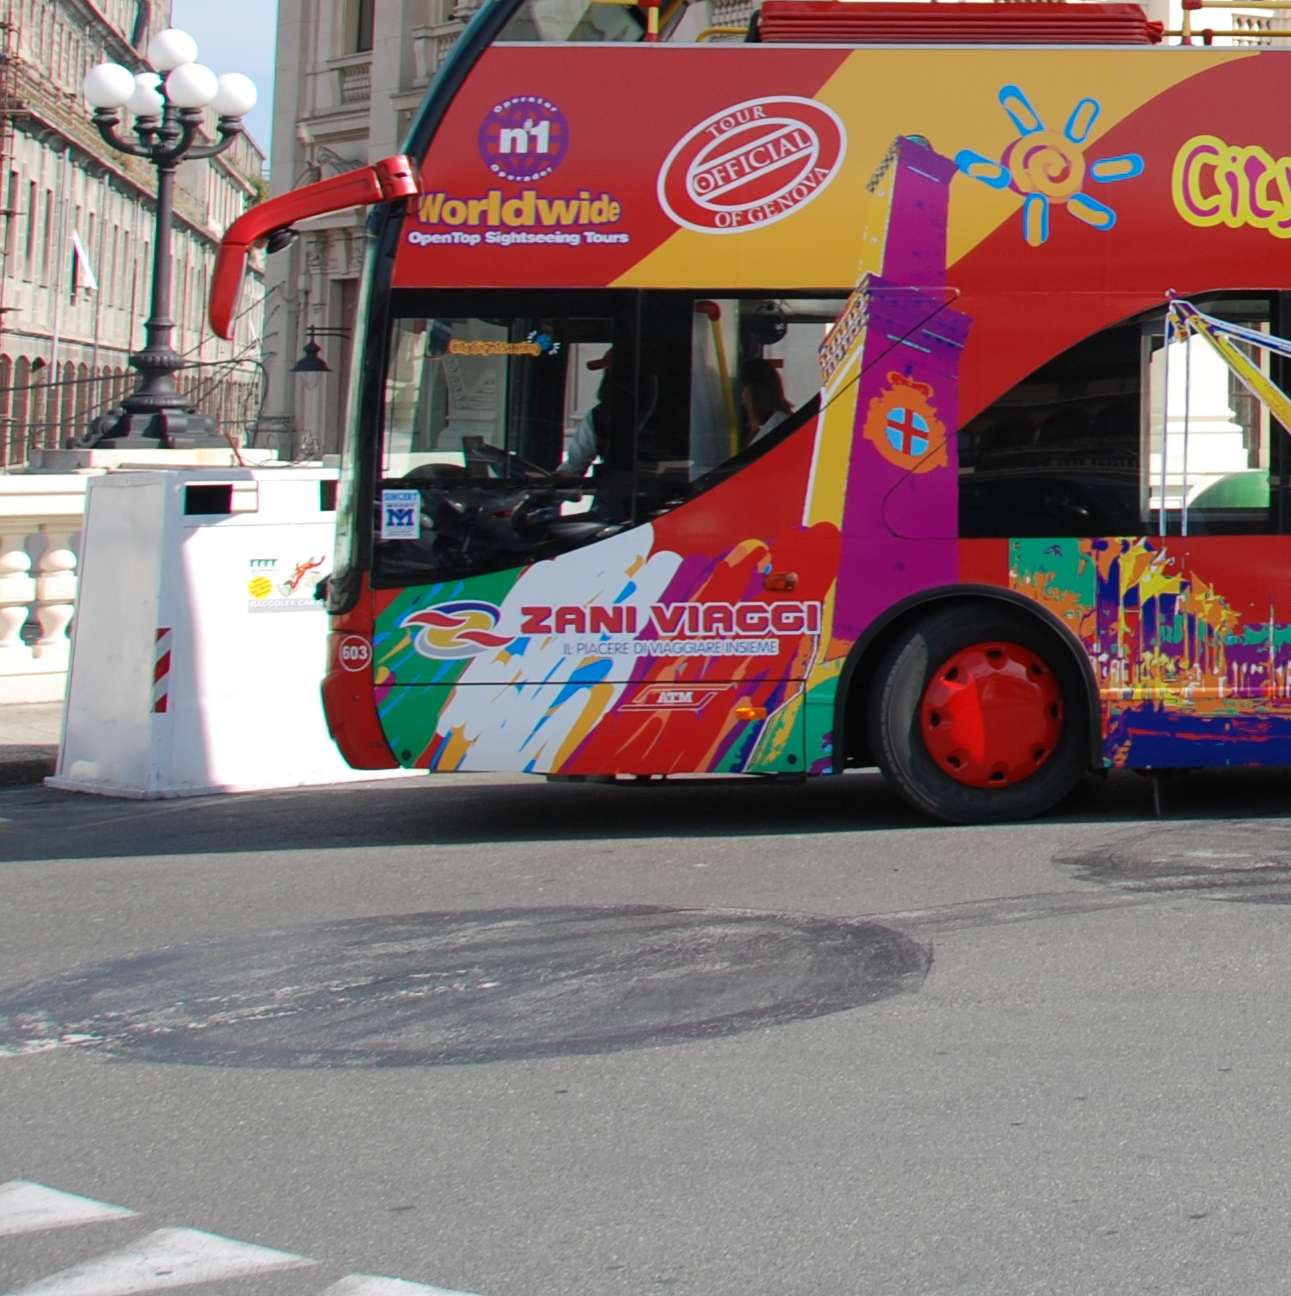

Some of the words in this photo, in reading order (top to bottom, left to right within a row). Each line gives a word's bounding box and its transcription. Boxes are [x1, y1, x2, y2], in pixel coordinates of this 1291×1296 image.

[705, 105, 766, 138] TOUR
[693, 129, 812, 194] OFFICIAL
[418, 190, 621, 227] Worldwide
[714, 211, 742, 228] OF
[747, 165, 831, 224] GENOVA
[408, 231, 481, 246] OpenTop
[484, 230, 581, 246] Sightseeing
[583, 231, 630, 244] Tours
[519, 604, 637, 634] ZANI
[648, 602, 821, 635] VIAGGI
[342, 645, 368, 660] 603
[564, 643, 572, 654] IL
[577, 641, 629, 654] PIACERE
[634, 642, 649, 653] DI
[650, 641, 721, 654] VIAGGIARE
[725, 641, 777, 653] INSIEME
[656, 691, 693, 703] ATM
